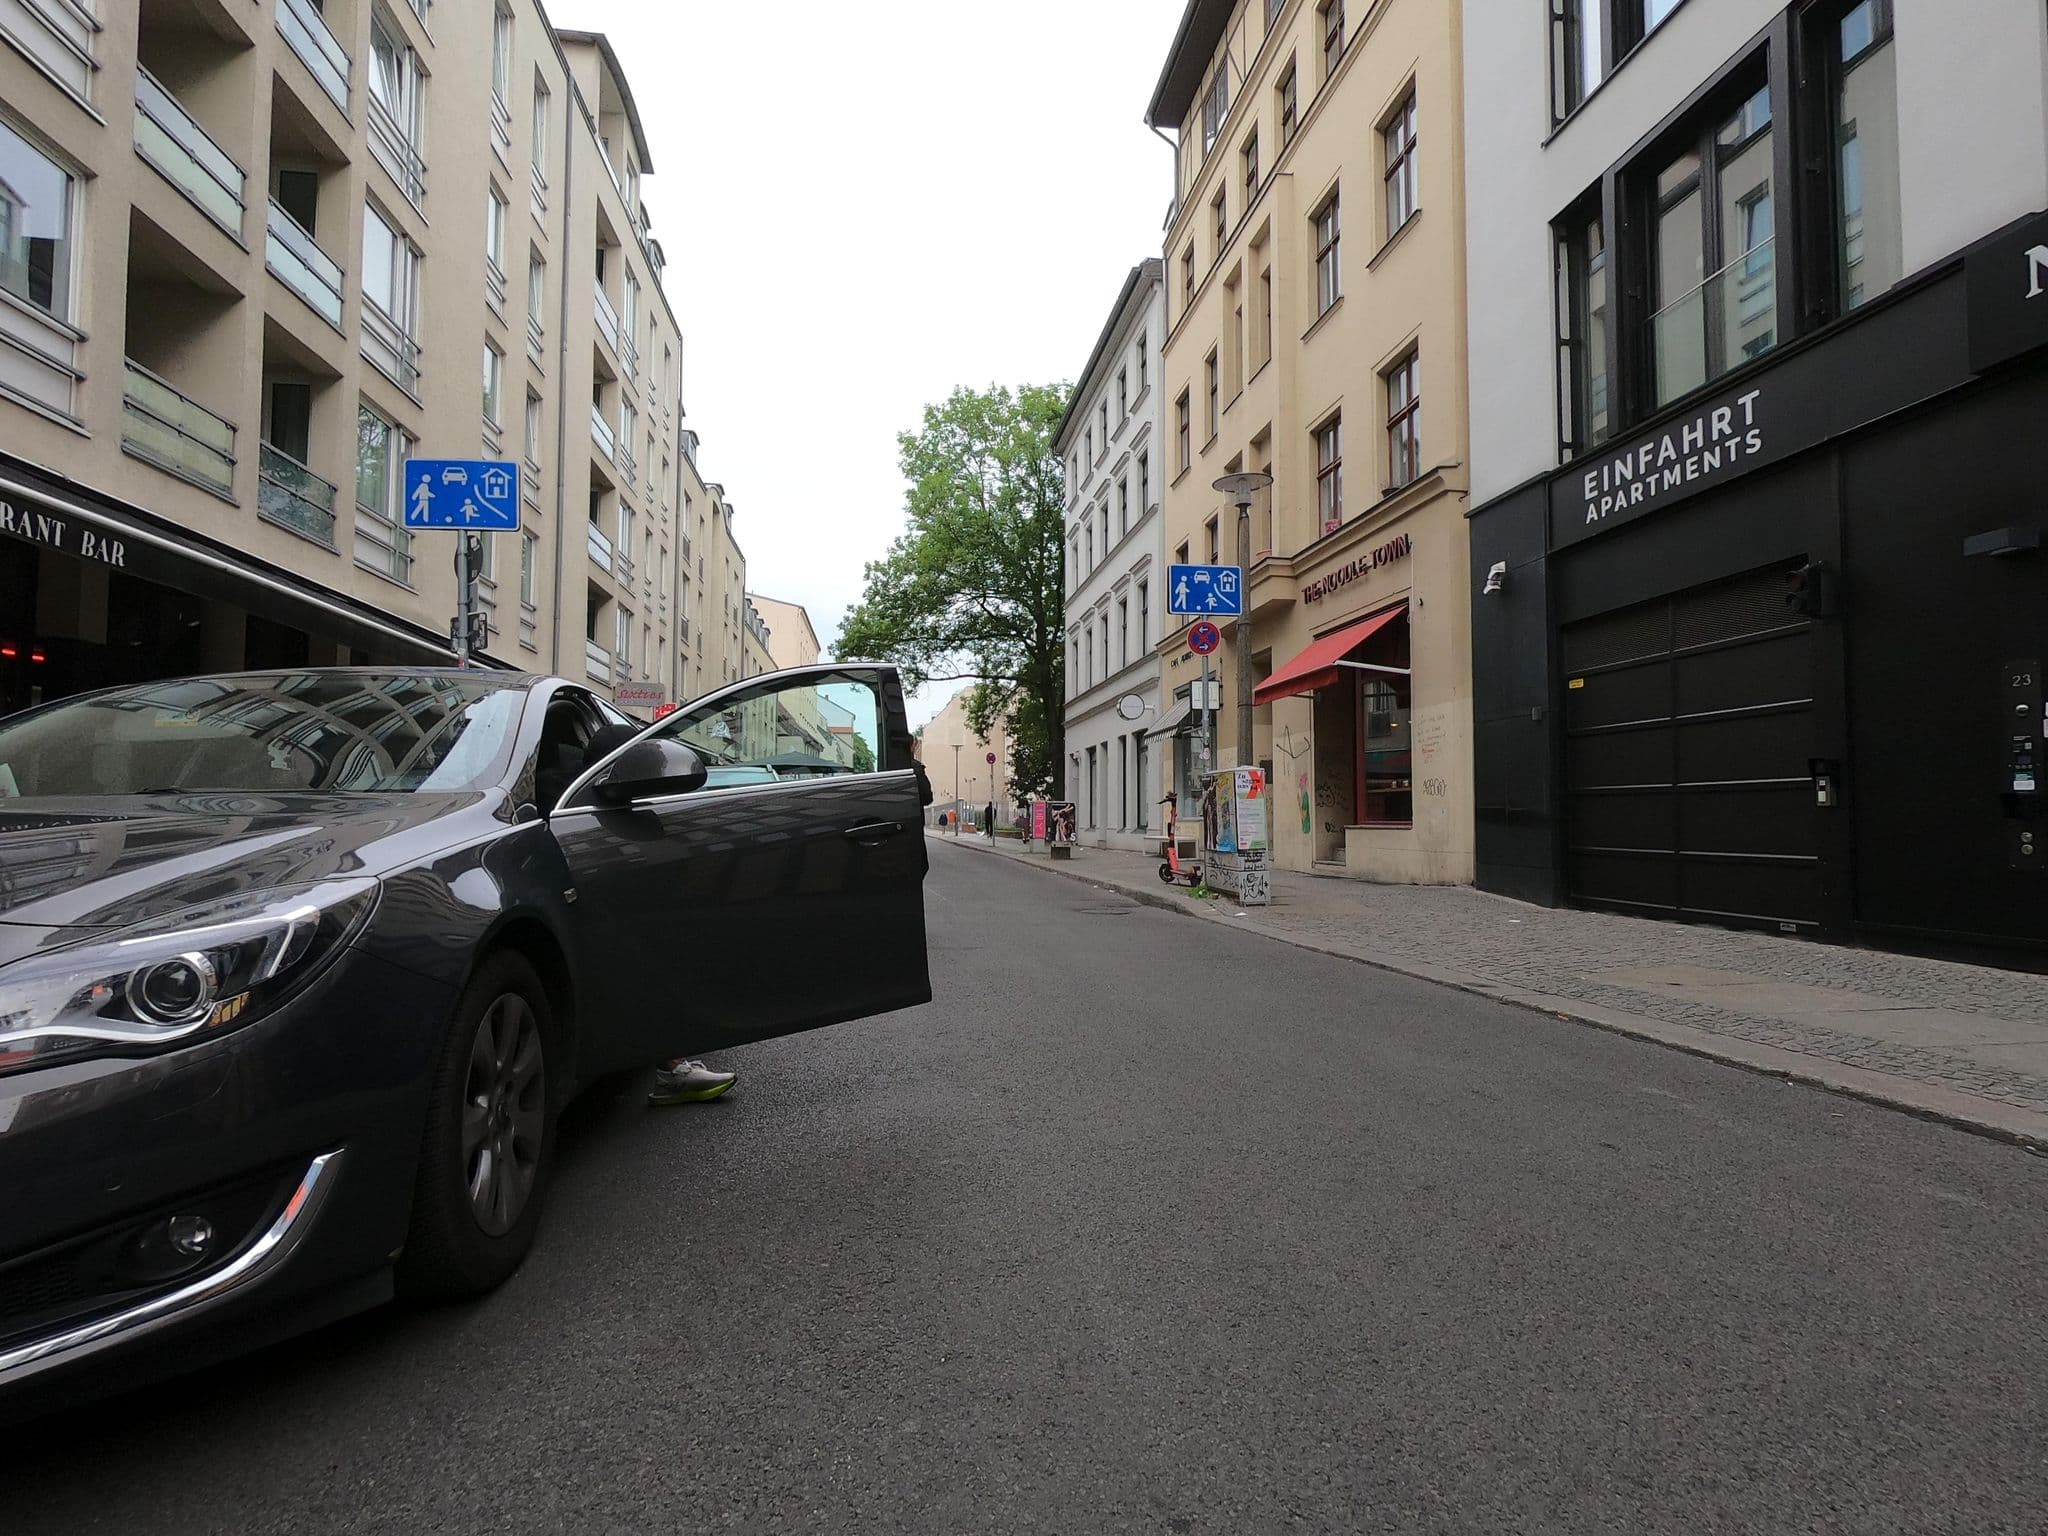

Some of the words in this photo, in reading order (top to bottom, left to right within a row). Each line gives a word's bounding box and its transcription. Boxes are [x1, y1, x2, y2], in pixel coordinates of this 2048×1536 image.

[1584, 389, 1761, 501] EINFAHRT
[1585, 428, 1762, 524] APARTMENTS
[0, 501, 66, 547] RANT
[81, 530, 125, 567] BAR
[1301, 579, 1323, 605] THE
[1322, 555, 1369, 595] NOODLE
[1369, 532, 1412, 570] TOWN
[2011, 673, 2032, 687] 23
